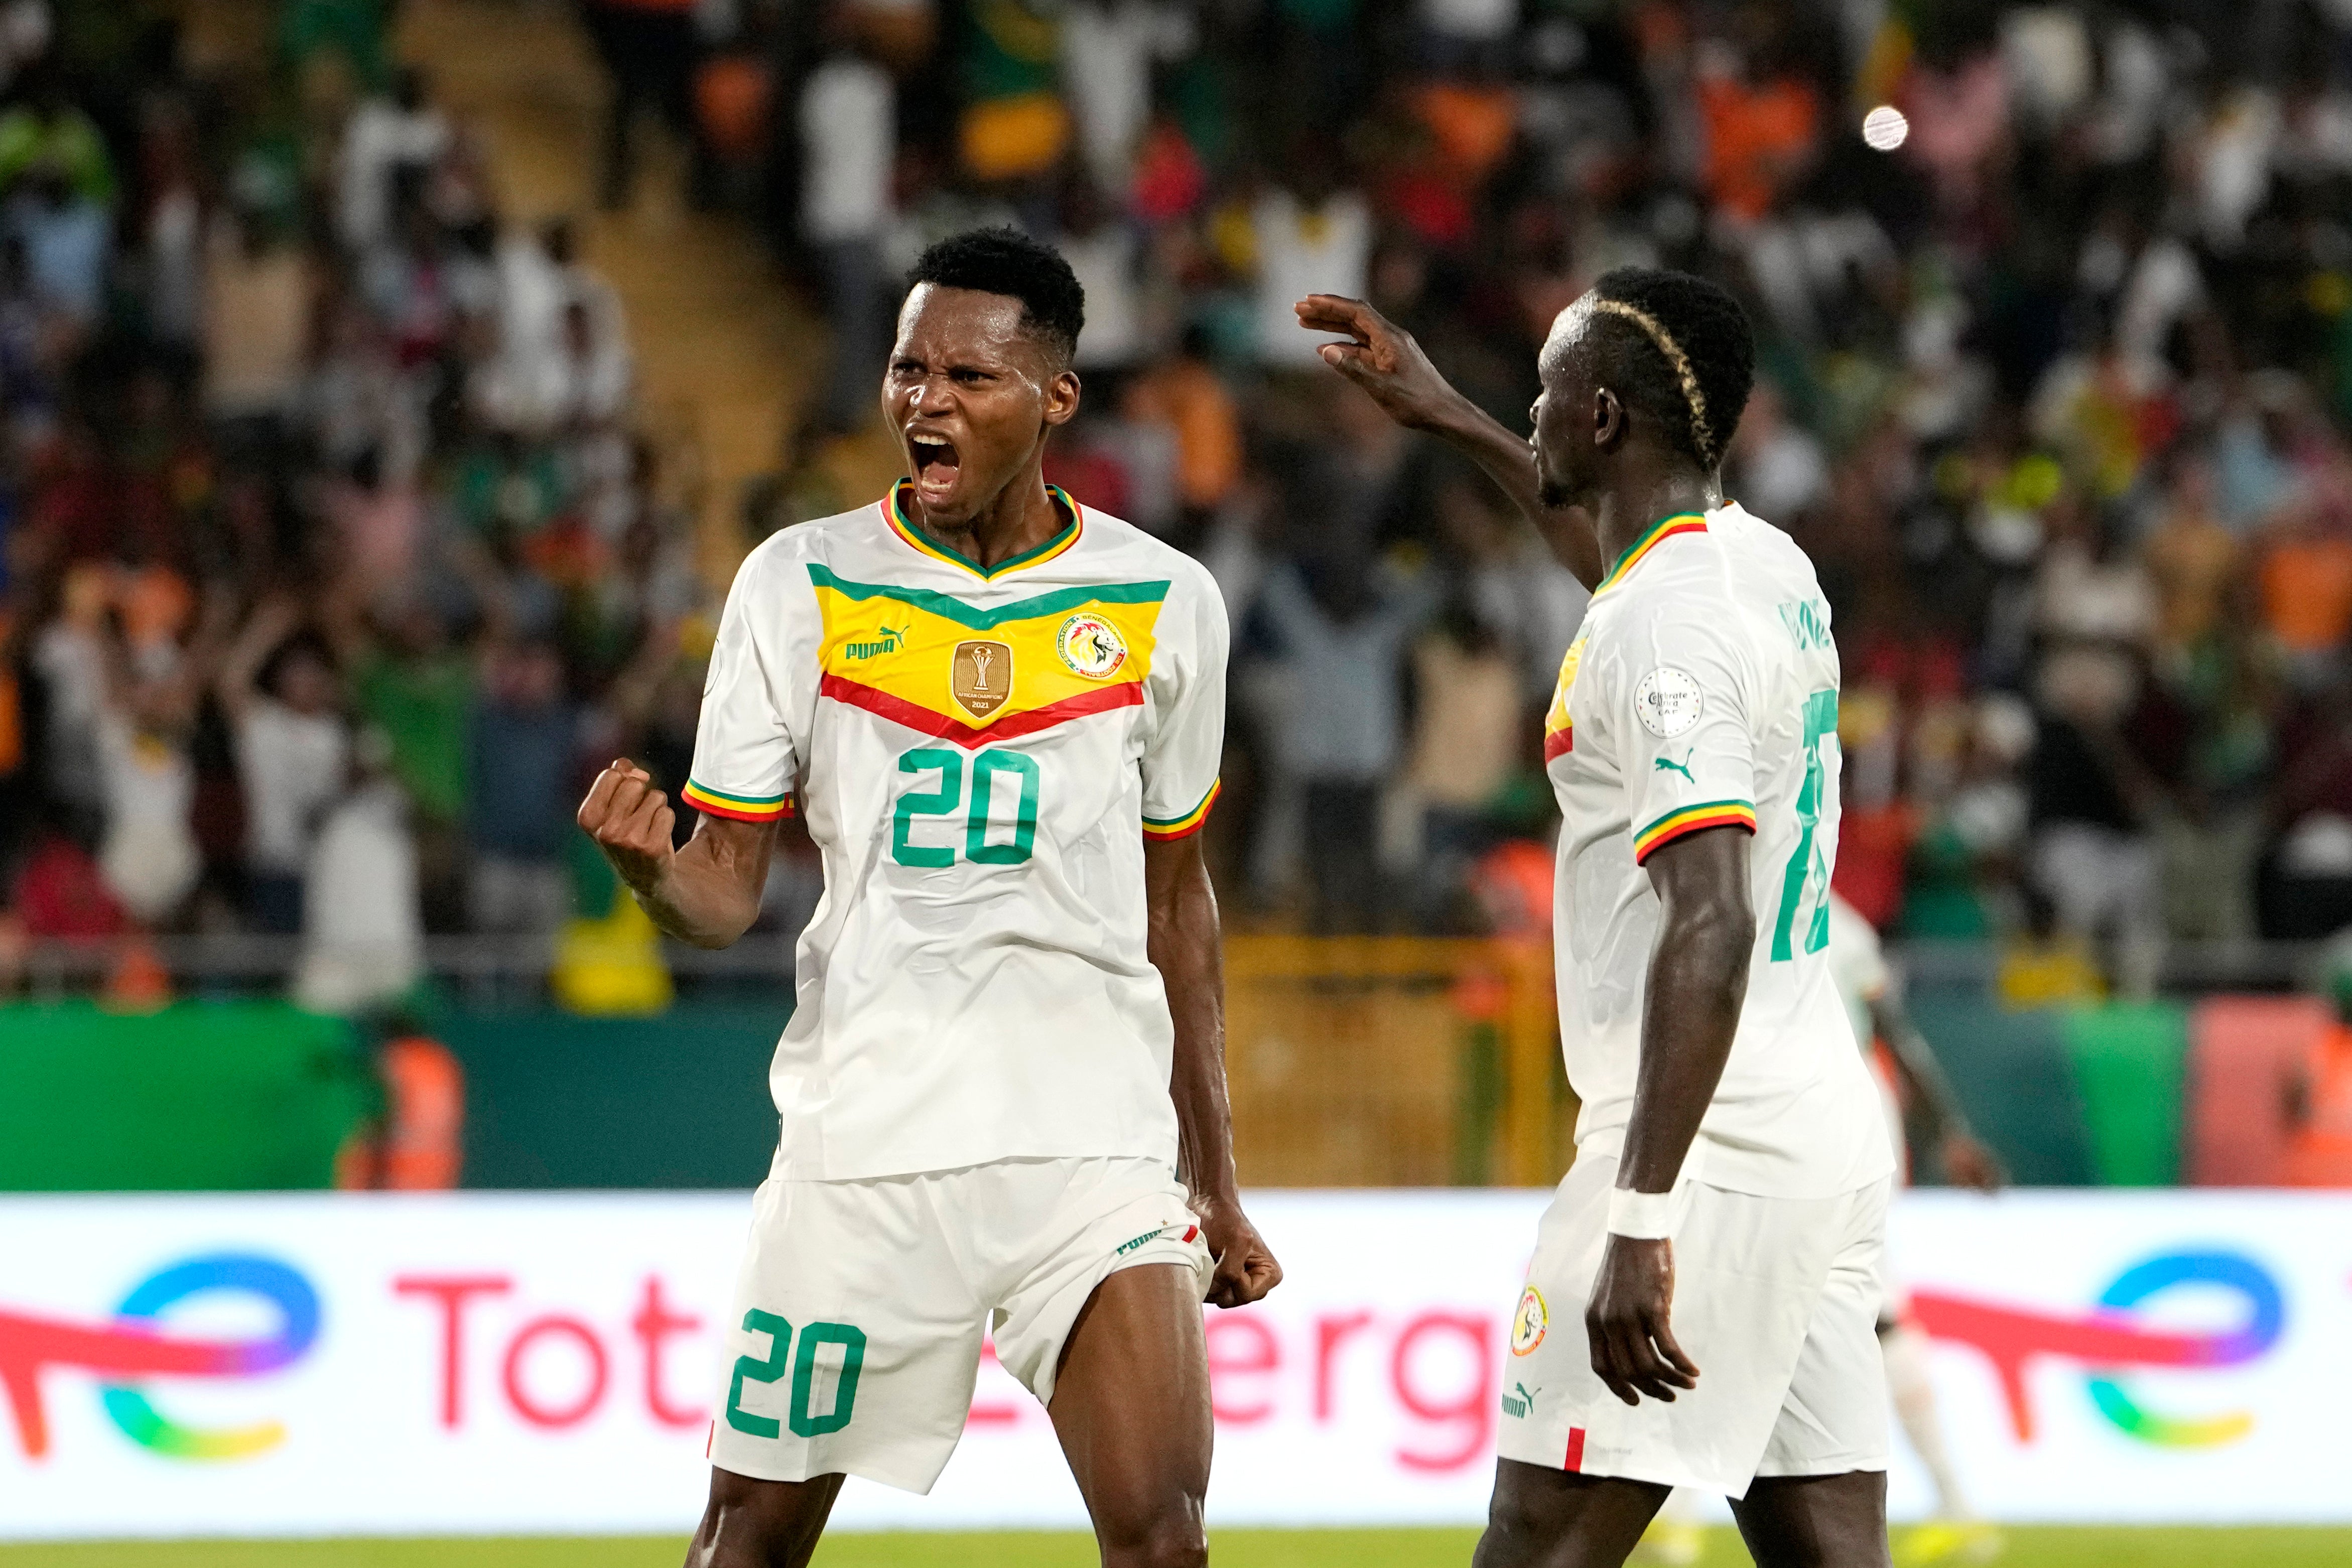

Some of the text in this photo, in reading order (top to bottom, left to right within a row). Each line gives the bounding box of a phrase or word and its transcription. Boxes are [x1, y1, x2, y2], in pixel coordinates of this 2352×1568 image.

[846, 638, 894, 660] PUMA
[892, 748, 1039, 868] 20
[725, 1307, 867, 1439] 20
